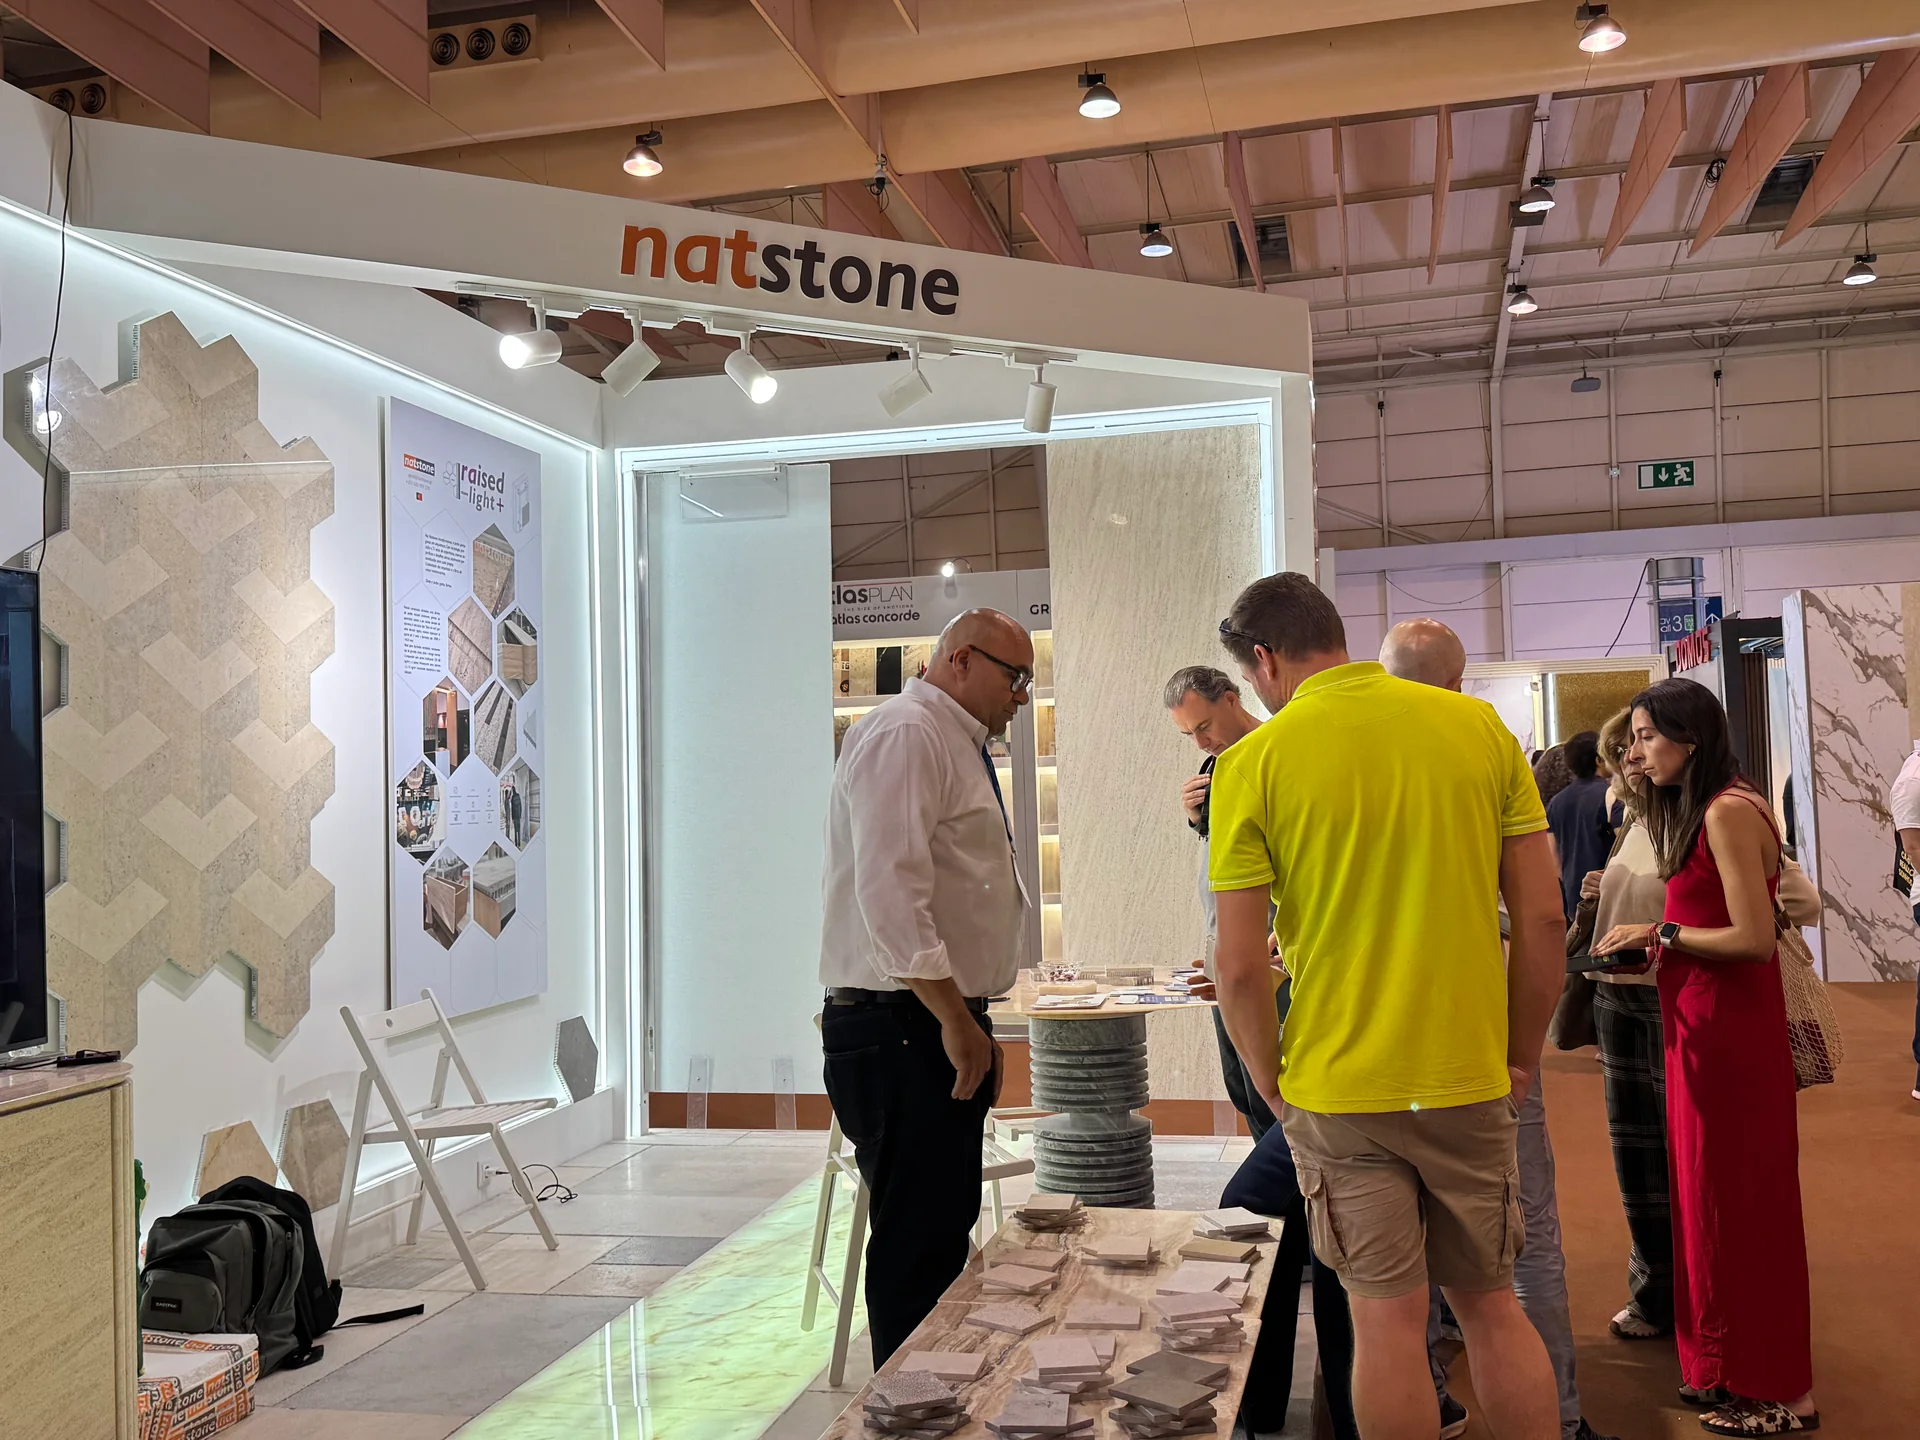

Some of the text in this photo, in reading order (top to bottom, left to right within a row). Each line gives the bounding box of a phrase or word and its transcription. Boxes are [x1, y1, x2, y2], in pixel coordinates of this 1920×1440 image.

[620, 224, 960, 316] natstone
[404, 457, 435, 474] natstone
[461, 464, 505, 494] raised
[862, 609, 920, 623] concorde
[1672, 615, 1683, 632] 3
